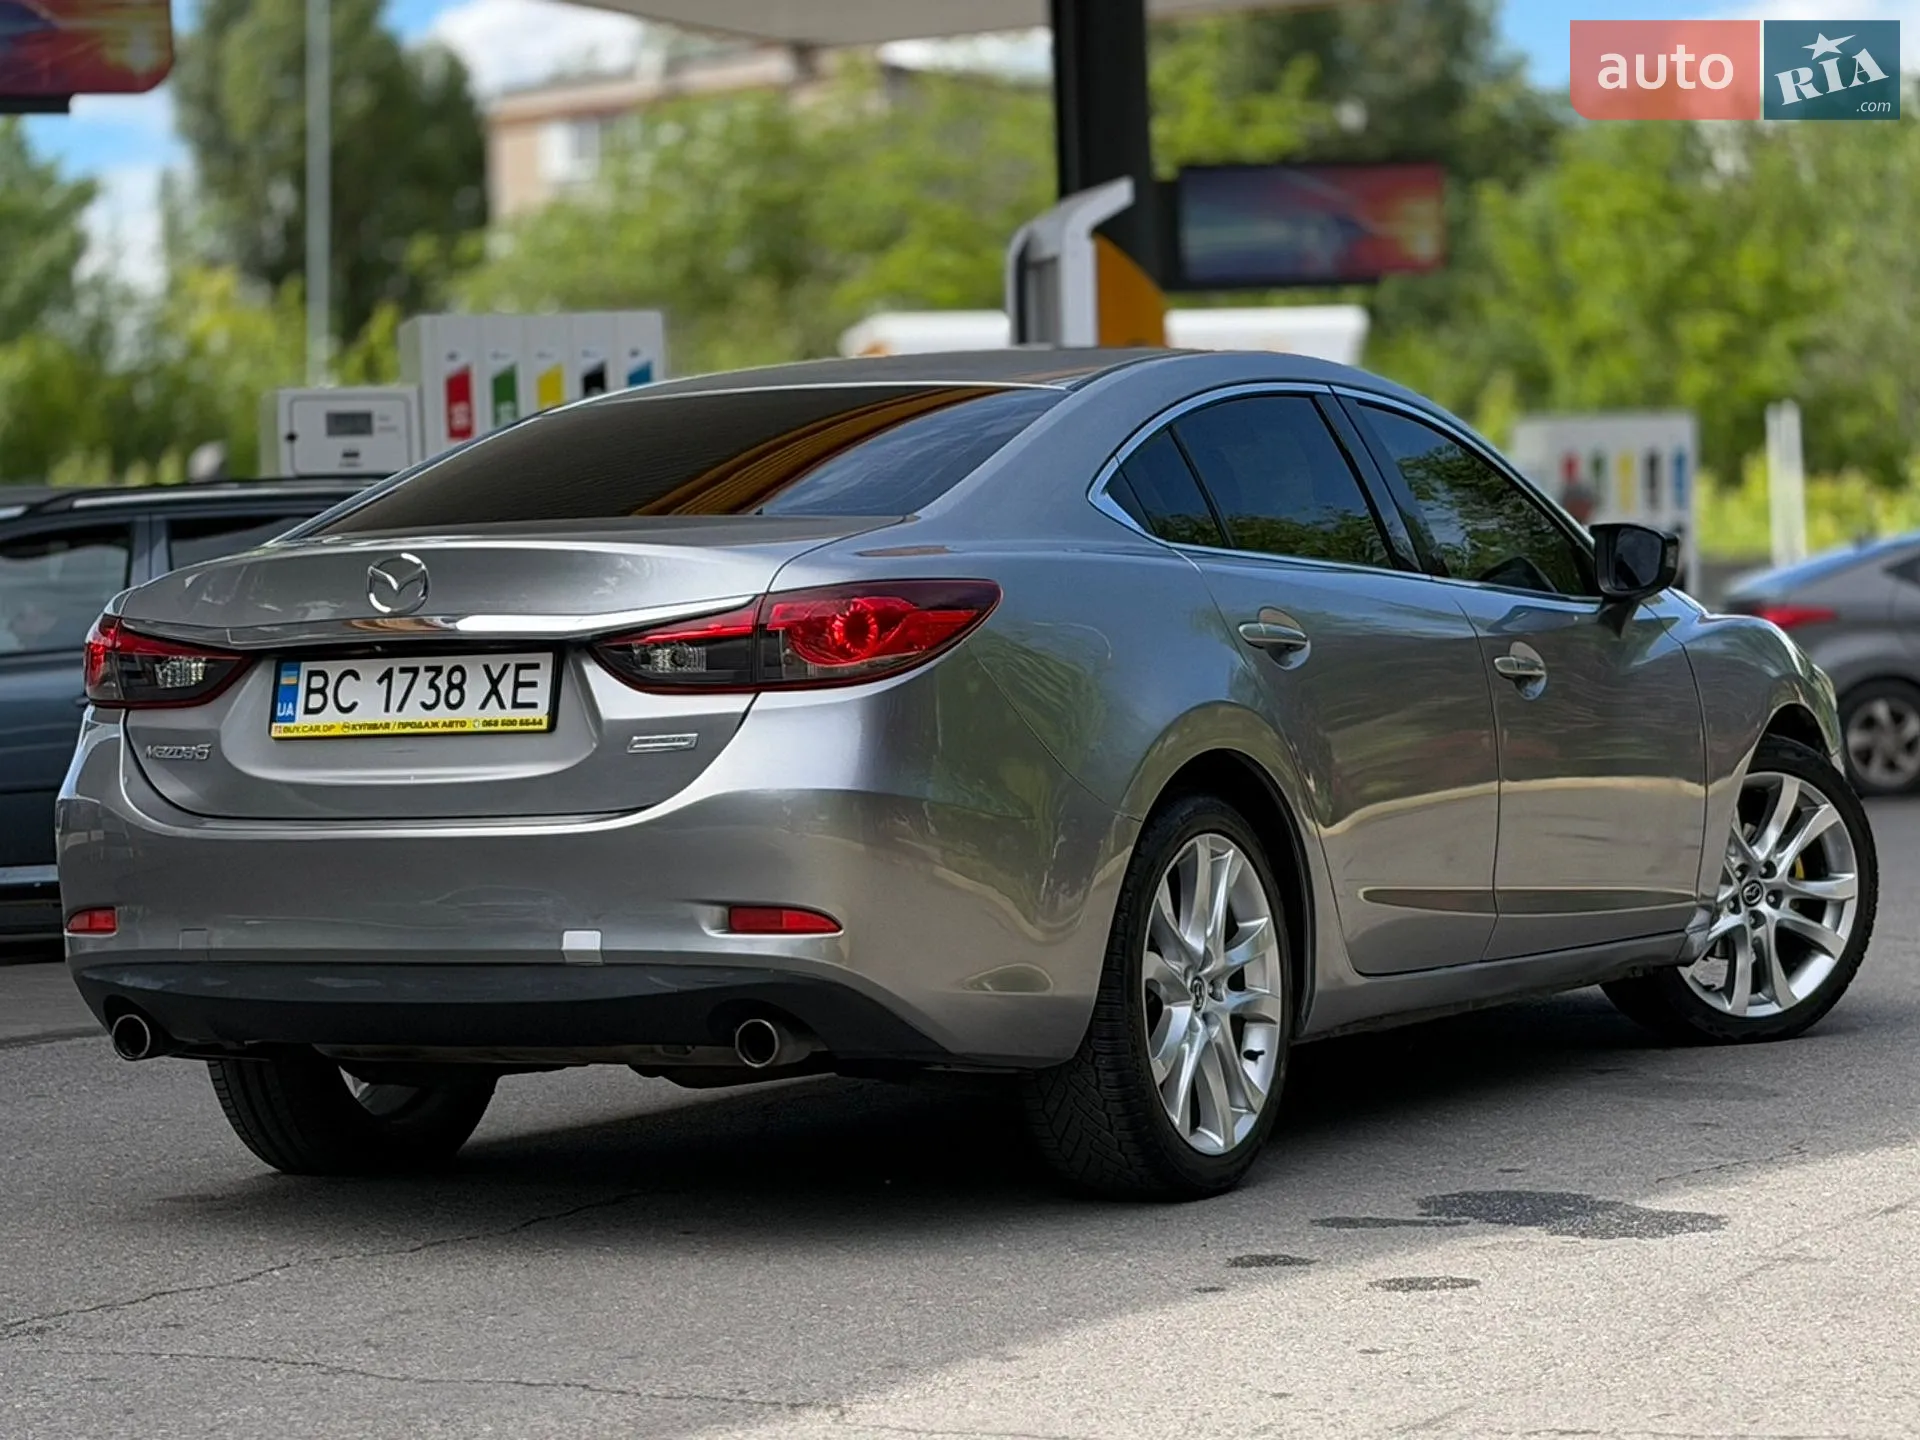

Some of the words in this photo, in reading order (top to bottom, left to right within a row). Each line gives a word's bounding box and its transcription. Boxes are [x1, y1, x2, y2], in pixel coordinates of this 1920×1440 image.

[302, 668, 361, 715] BC
[376, 664, 467, 714] 1738
[478, 661, 541, 711] XE
[277, 701, 294, 717] UA
[397, 720, 439, 731] ПРОДАЖ
[441, 719, 467, 729] АВТО
